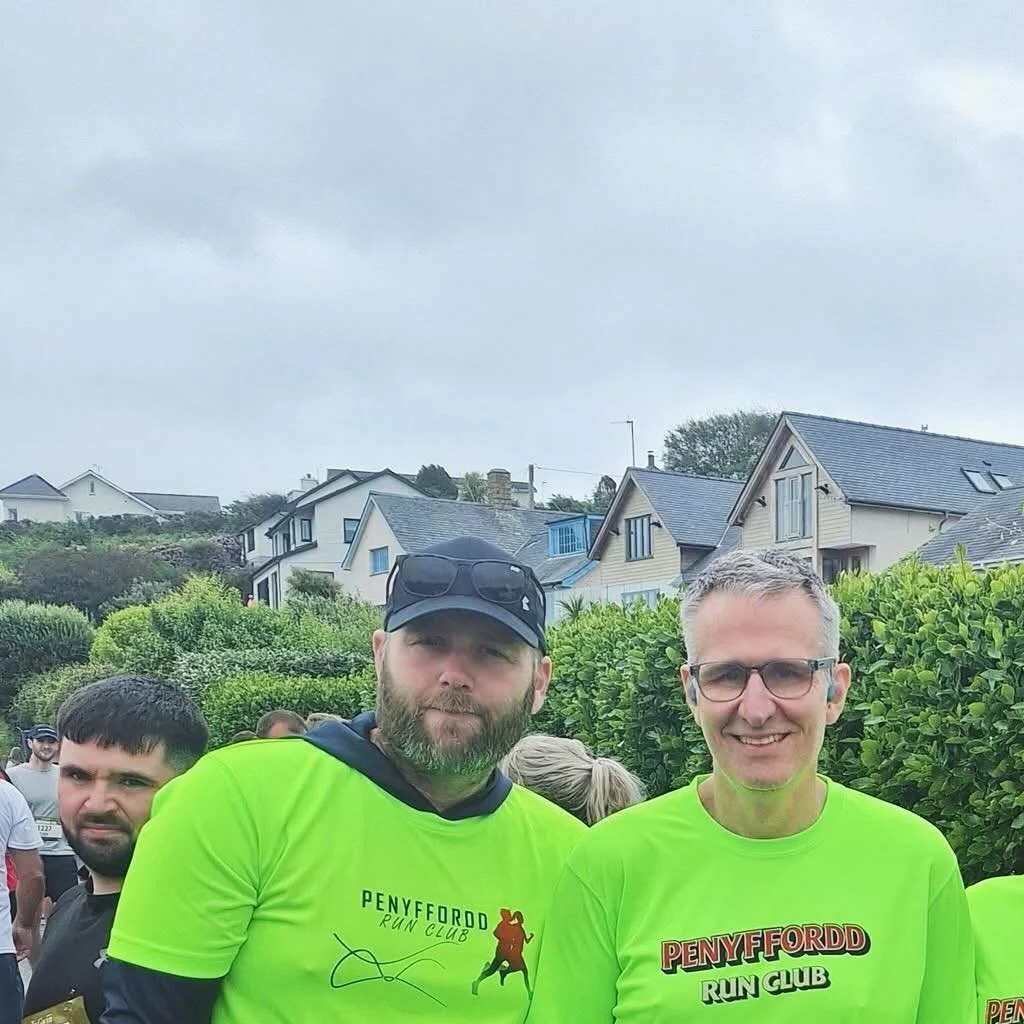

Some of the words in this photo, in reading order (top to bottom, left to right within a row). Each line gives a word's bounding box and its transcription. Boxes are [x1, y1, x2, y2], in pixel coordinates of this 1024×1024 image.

[362, 889, 488, 931] PENYFFORDD
[380, 914, 418, 933] RUN
[425, 928, 469, 943] CLUB
[661, 924, 871, 974] PENYFFORDD
[701, 975, 759, 1005] RUN
[762, 966, 832, 996] CLUB
